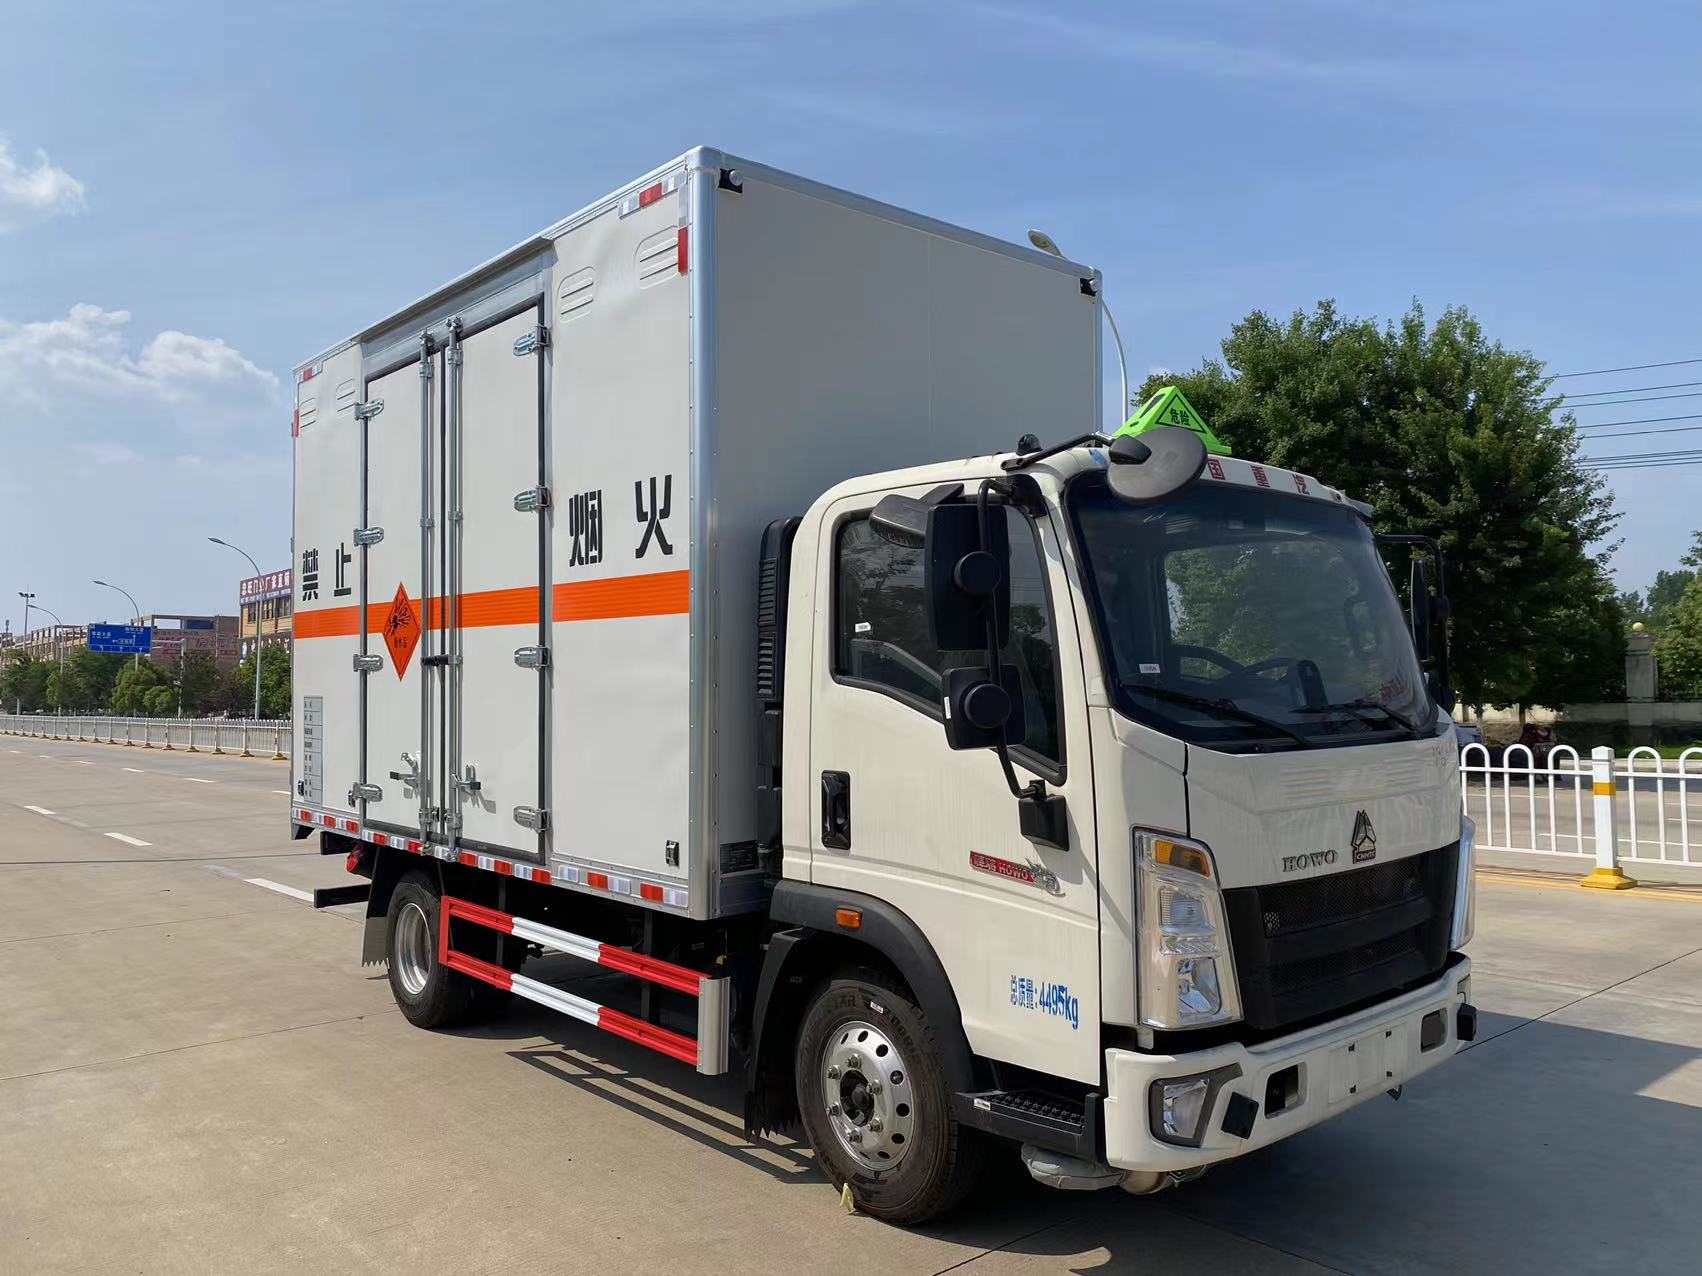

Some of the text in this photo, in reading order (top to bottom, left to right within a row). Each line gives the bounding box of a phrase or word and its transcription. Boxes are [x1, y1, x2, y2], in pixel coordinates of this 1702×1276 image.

[1169, 407, 1191, 426] 危险
[1281, 849, 1339, 873] HOWO
[999, 862, 1029, 880] HOWO
